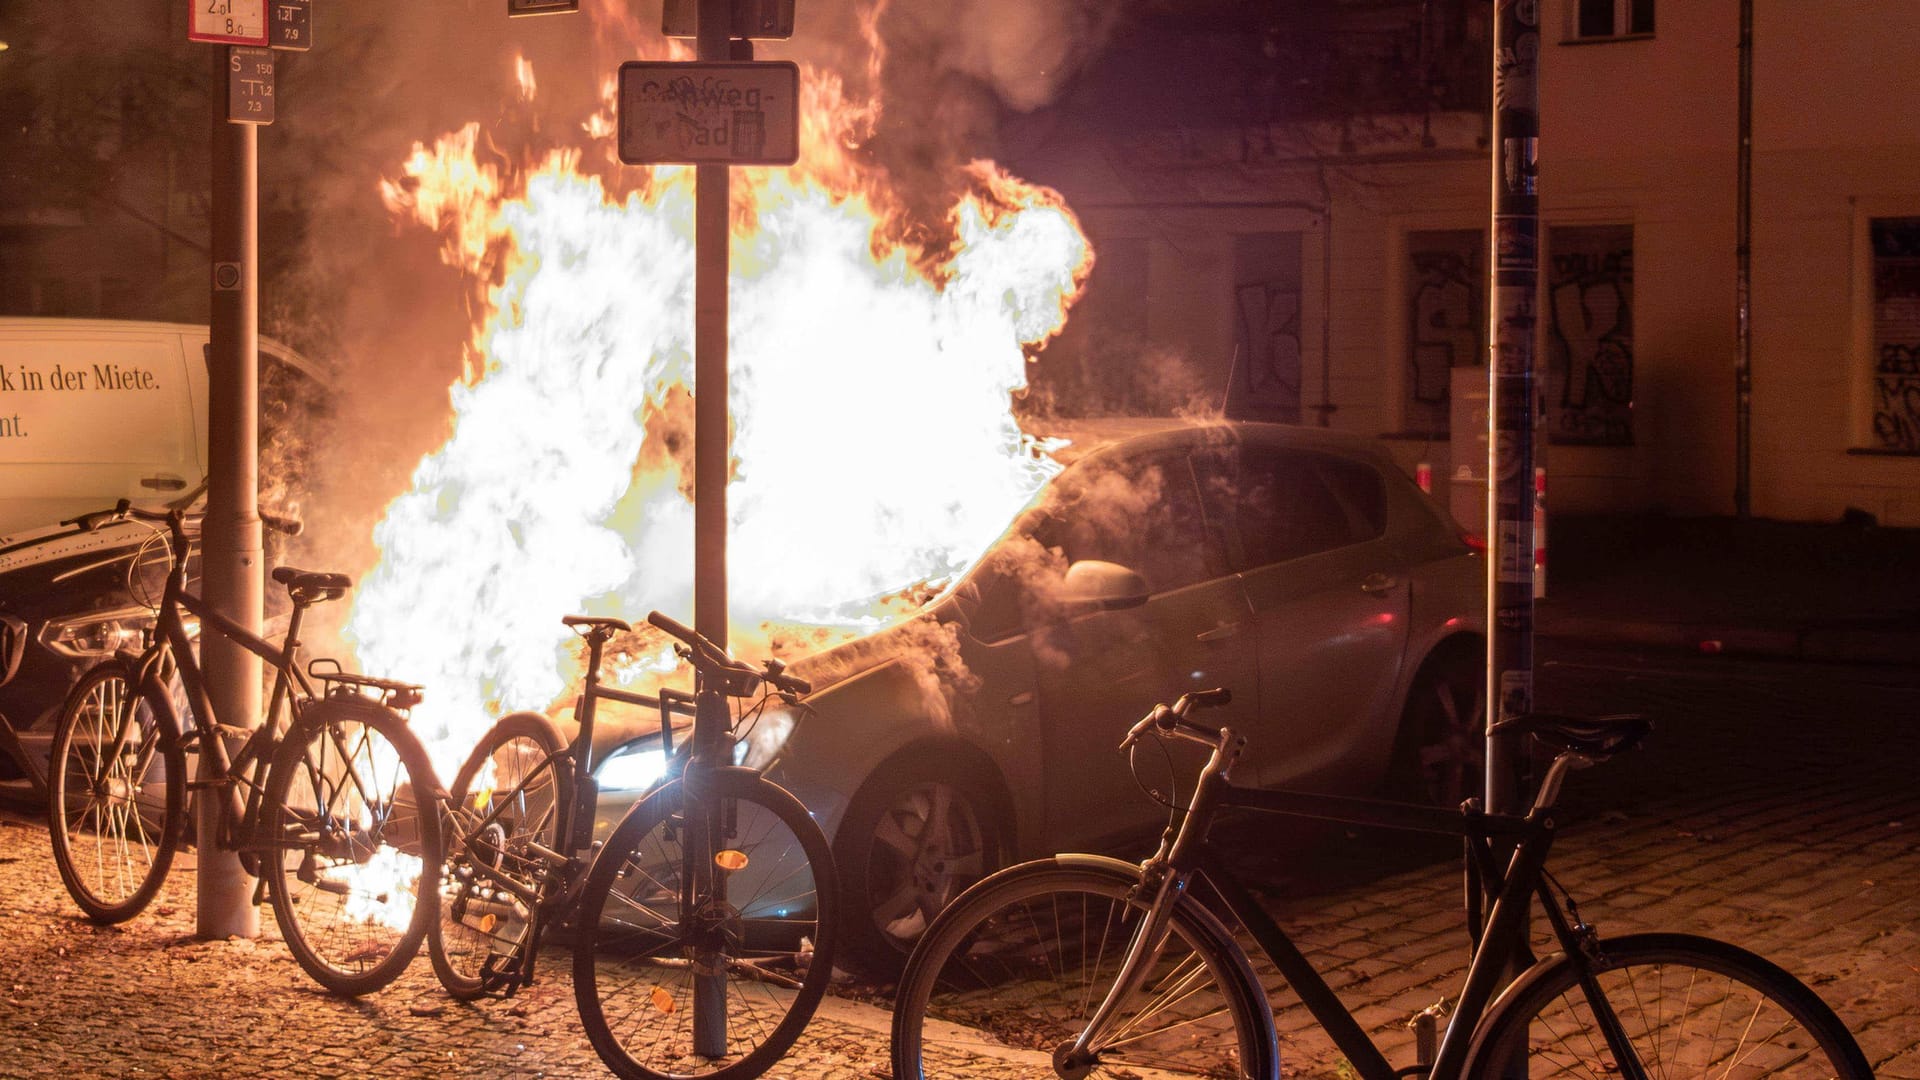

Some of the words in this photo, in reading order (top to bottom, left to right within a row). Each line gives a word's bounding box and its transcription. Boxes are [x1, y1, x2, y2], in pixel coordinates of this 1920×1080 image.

[231, 56, 241, 72] S
[256, 64, 272, 75] 150
[20, 365, 43, 391] in
[50, 364, 88, 391] der
[92, 364, 160, 391] Miete.
